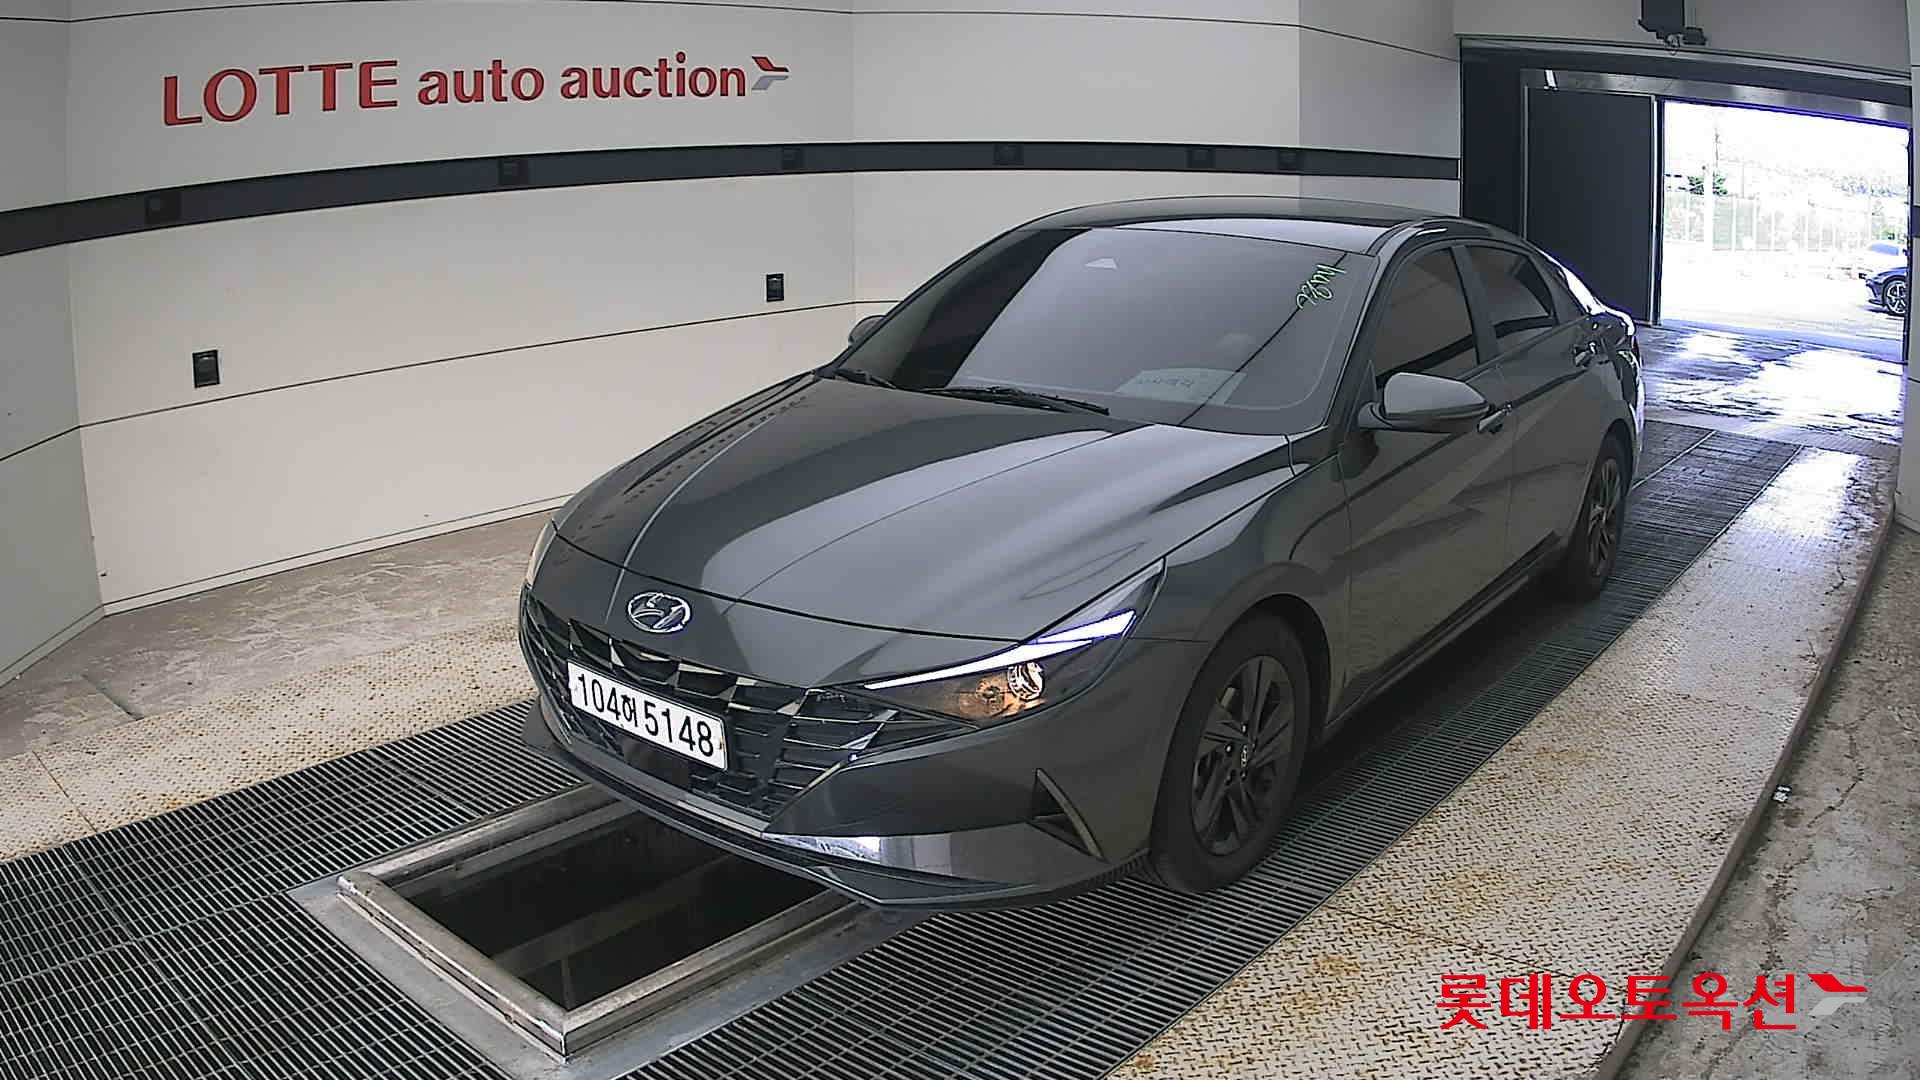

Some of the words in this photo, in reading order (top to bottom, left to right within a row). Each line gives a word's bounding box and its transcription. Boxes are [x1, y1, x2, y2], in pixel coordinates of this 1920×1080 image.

[162, 59, 399, 126] LOTTE
[416, 58, 545, 106] auto
[560, 51, 747, 98] auction
